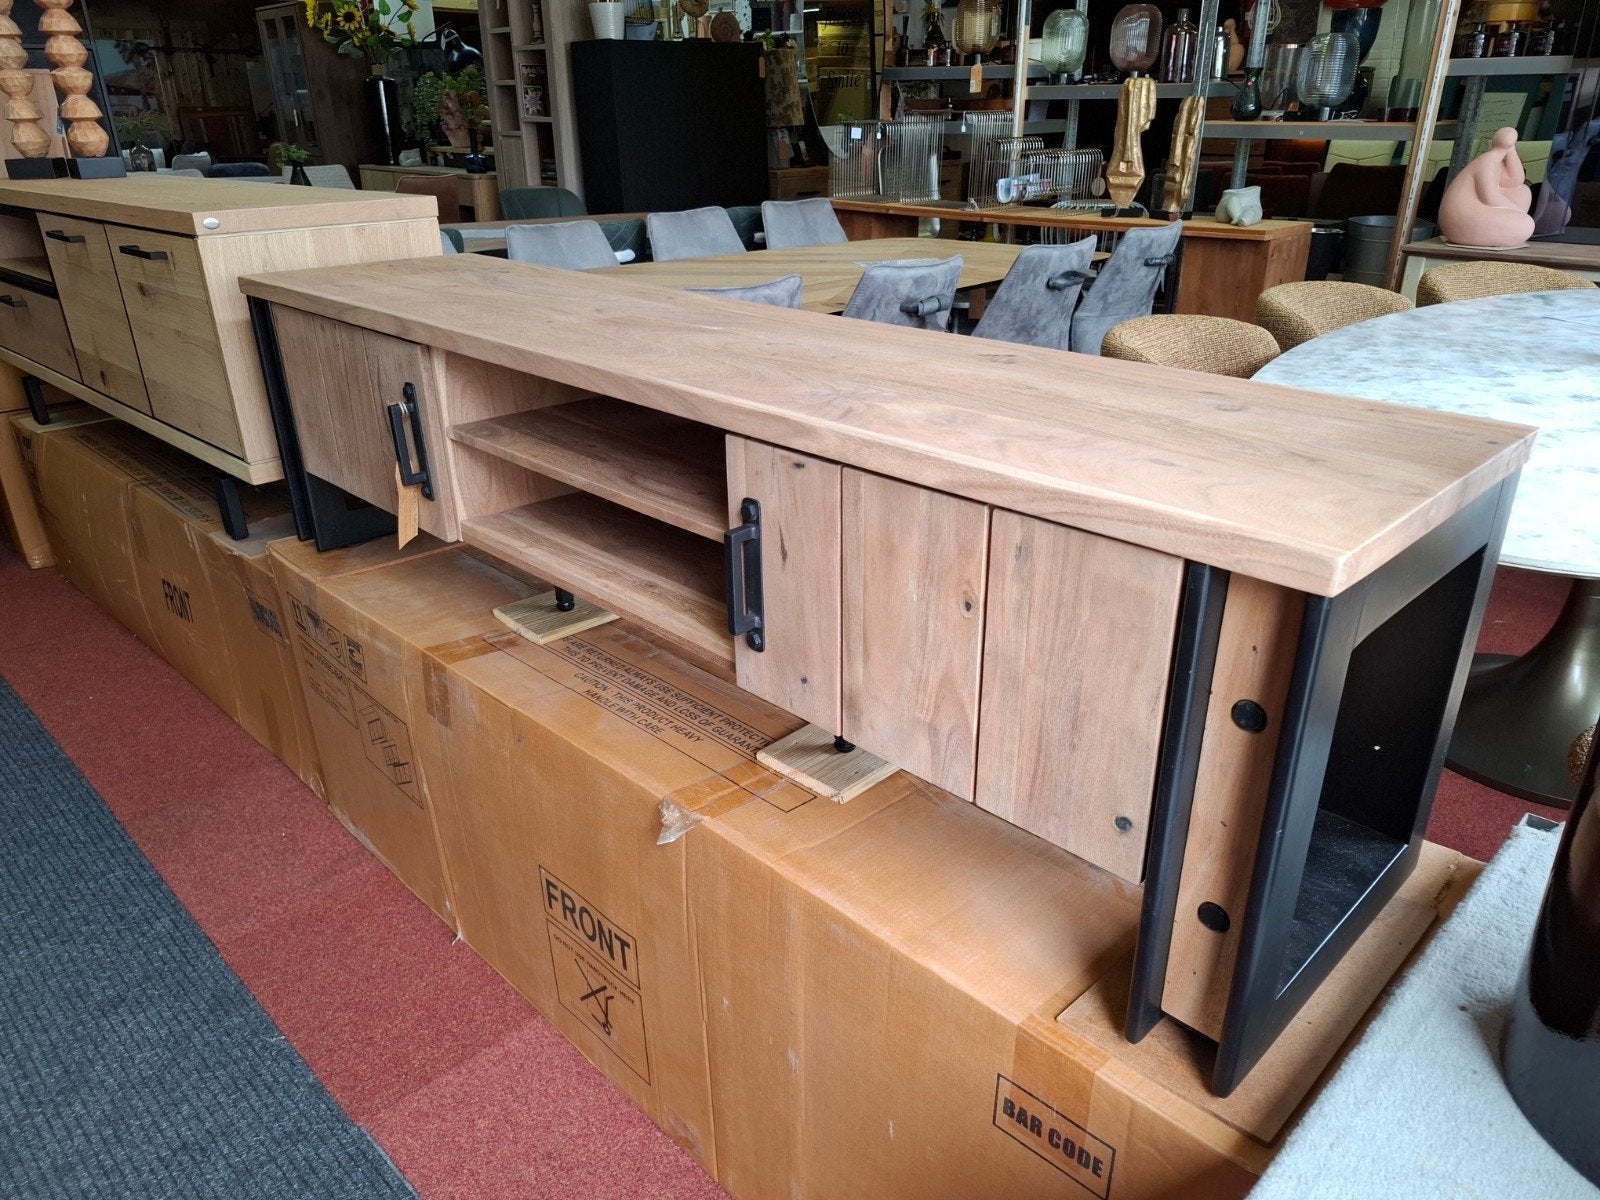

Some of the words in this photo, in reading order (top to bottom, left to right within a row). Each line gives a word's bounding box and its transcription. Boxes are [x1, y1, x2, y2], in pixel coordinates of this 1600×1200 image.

[828, 71, 861, 88] Smile
[161, 578, 194, 623] FRONT
[577, 655, 591, 663] TO
[588, 660, 625, 680] PREVENT
[621, 679, 658, 699] DAMAGE
[656, 695, 677, 709] AND
[675, 705, 701, 721] LOSS
[698, 718, 716, 728] OF
[583, 688, 616, 709] HANDLE
[615, 704, 640, 720] WITH
[636, 718, 666, 735] CARE
[585, 648, 626, 670] RETURNED
[623, 667, 657, 686] ALWAYS
[655, 681, 675, 695] USE
[671, 691, 723, 720] SUFFICIENT
[613, 691, 634, 705] THIS
[631, 703, 674, 727] PRODUCT
[670, 724, 705, 743] HEAVY
[545, 878, 631, 971] FRONT
[1002, 1096, 1043, 1139] BAR
[1047, 1128, 1104, 1179] CODE
